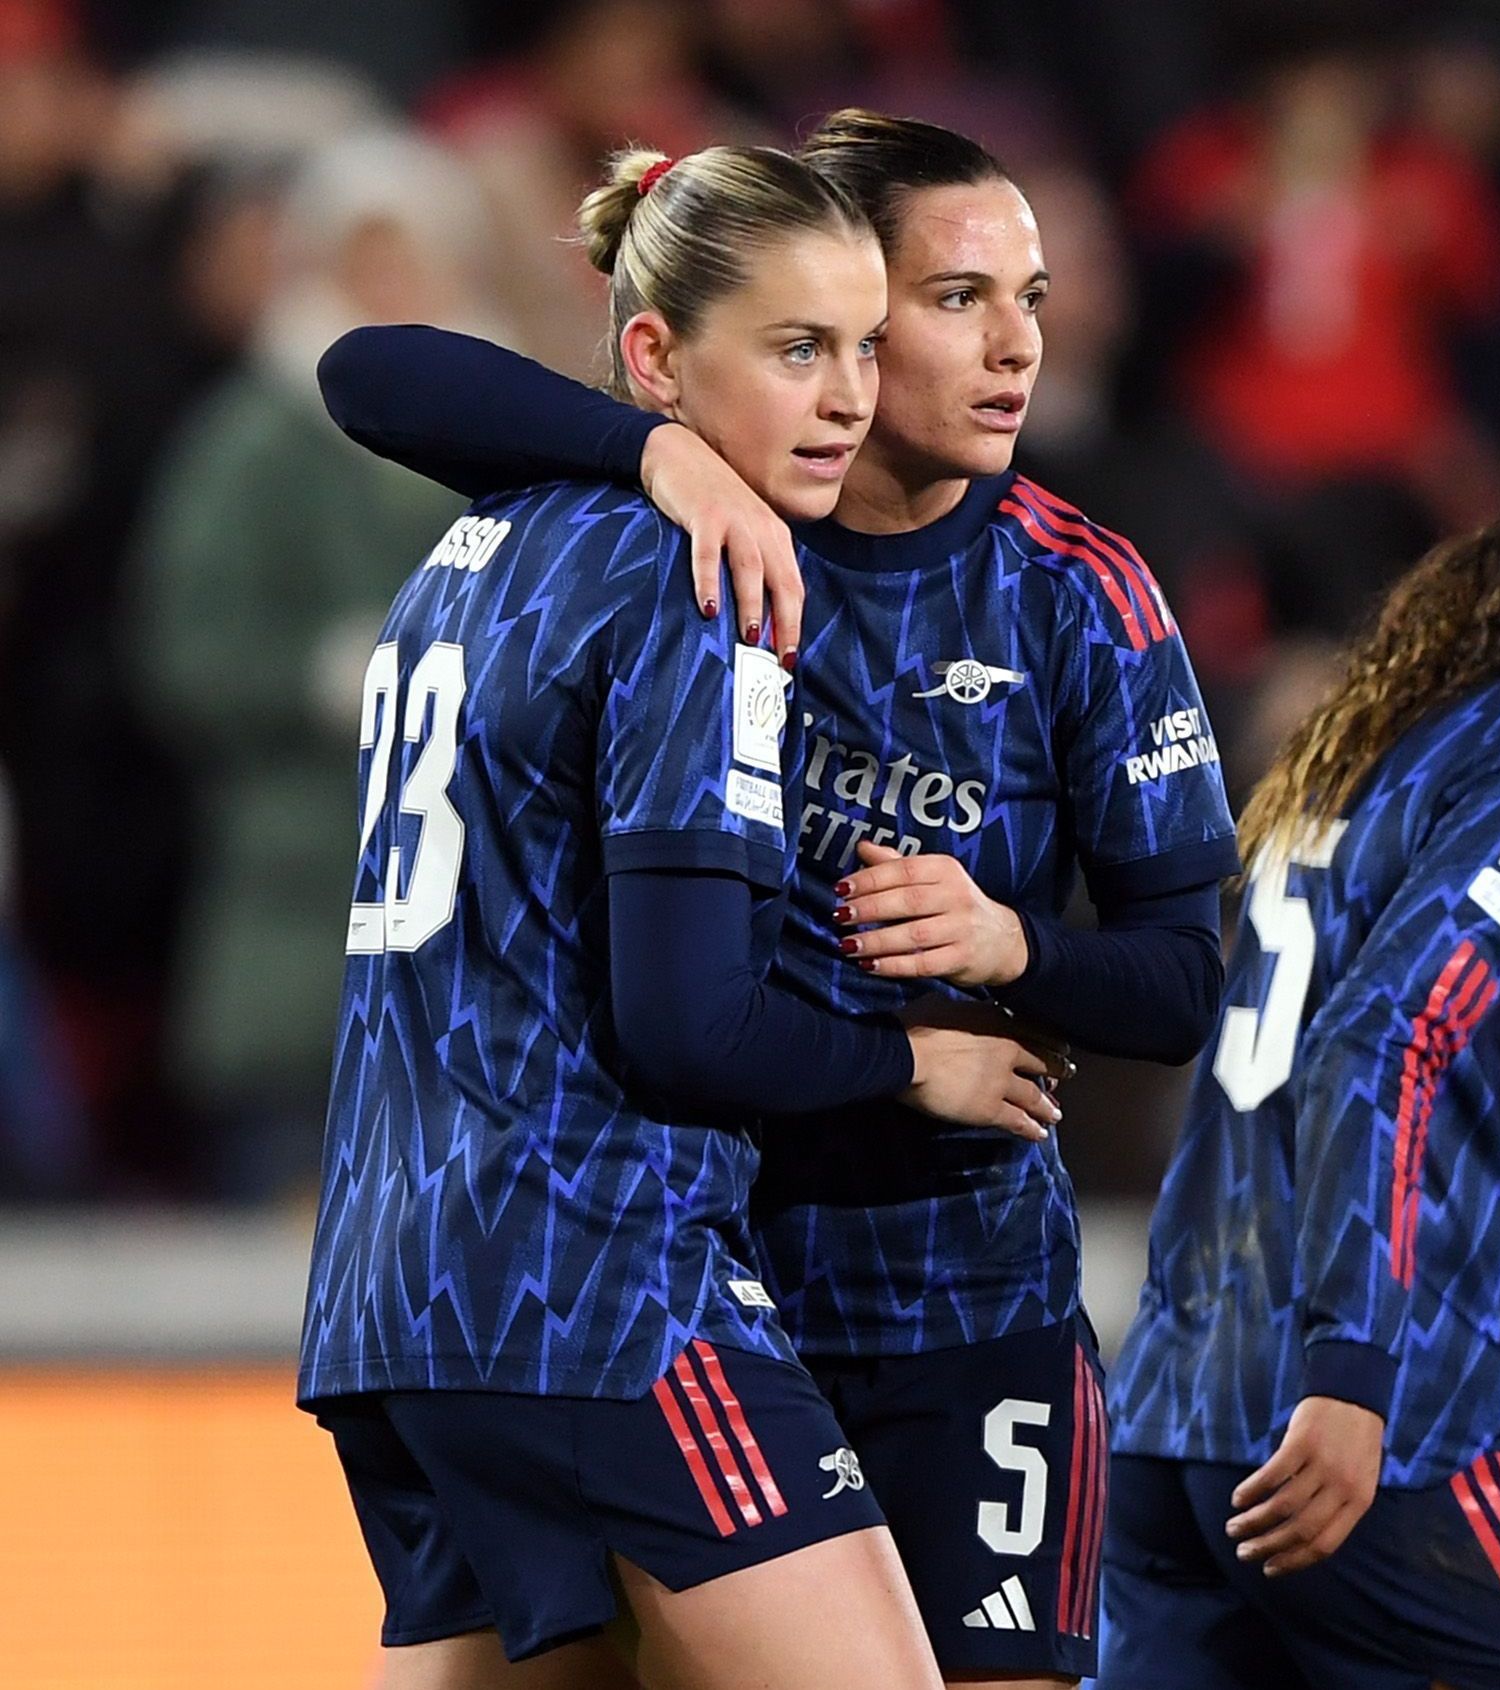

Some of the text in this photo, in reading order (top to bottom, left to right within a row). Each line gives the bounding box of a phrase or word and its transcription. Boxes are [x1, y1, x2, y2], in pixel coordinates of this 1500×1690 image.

[344, 640, 467, 956] 23
[802, 712, 987, 834] rates
[1126, 734, 1220, 785] RWANDA
[976, 1397, 1052, 1557] 5
